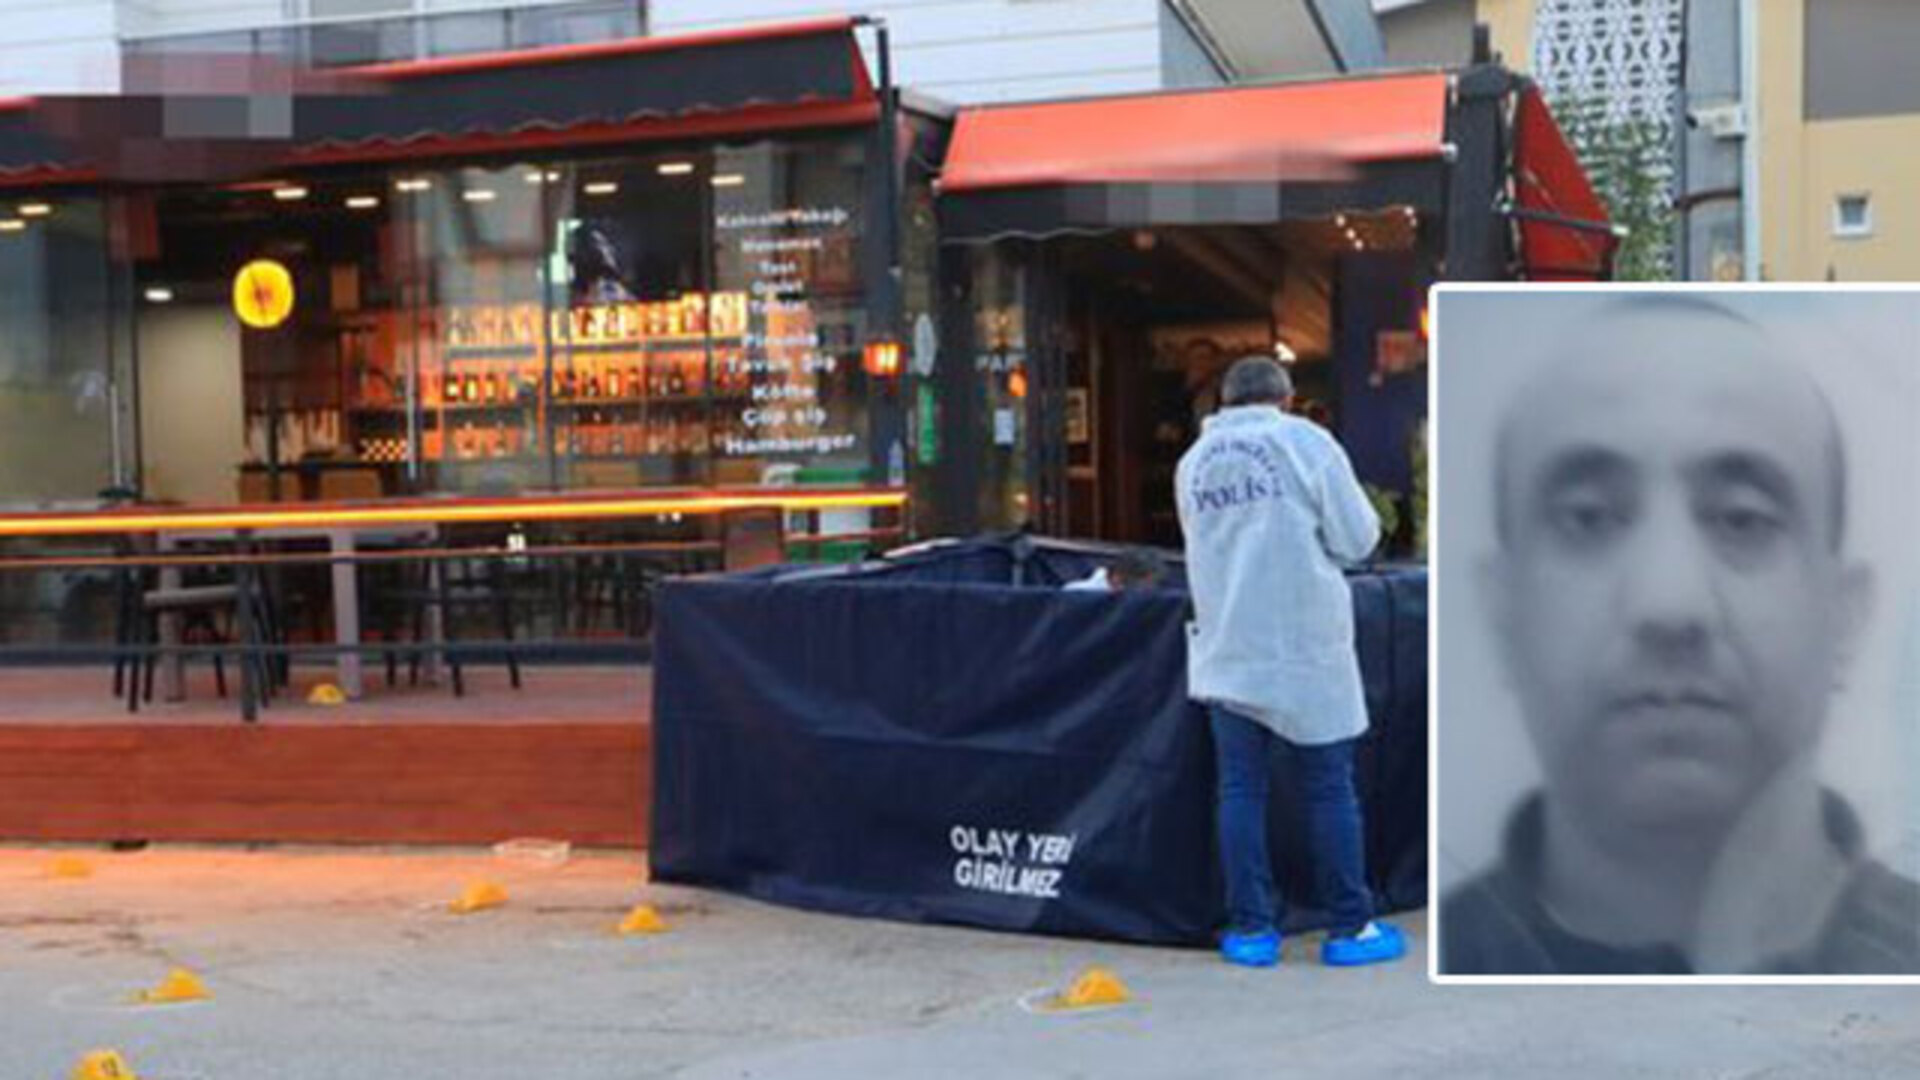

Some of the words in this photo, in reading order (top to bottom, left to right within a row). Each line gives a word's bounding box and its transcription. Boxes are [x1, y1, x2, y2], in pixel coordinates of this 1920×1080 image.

[725, 433, 856, 455] Hamburger
[950, 825, 1020, 859] OLAY
[954, 856, 1063, 898] GİRİLMEZ
